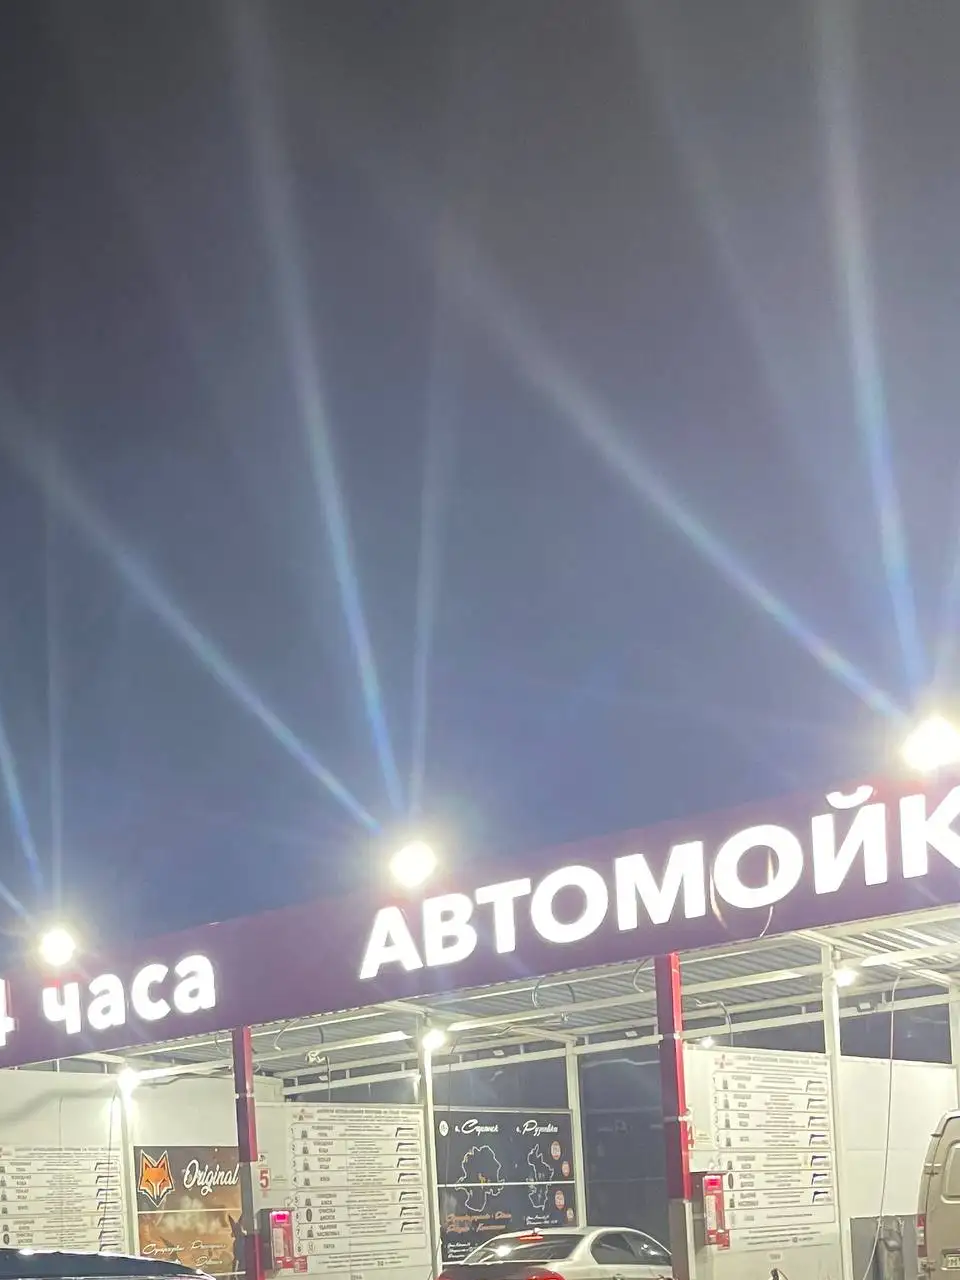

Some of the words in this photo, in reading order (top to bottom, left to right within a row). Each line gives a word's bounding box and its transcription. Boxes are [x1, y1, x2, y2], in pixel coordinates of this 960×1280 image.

[359, 785, 960, 980] АВТОМОЙК
[42, 954, 217, 1037] часа
[183, 1158, 240, 1196] Original
[259, 1168, 269, 1189] 5
